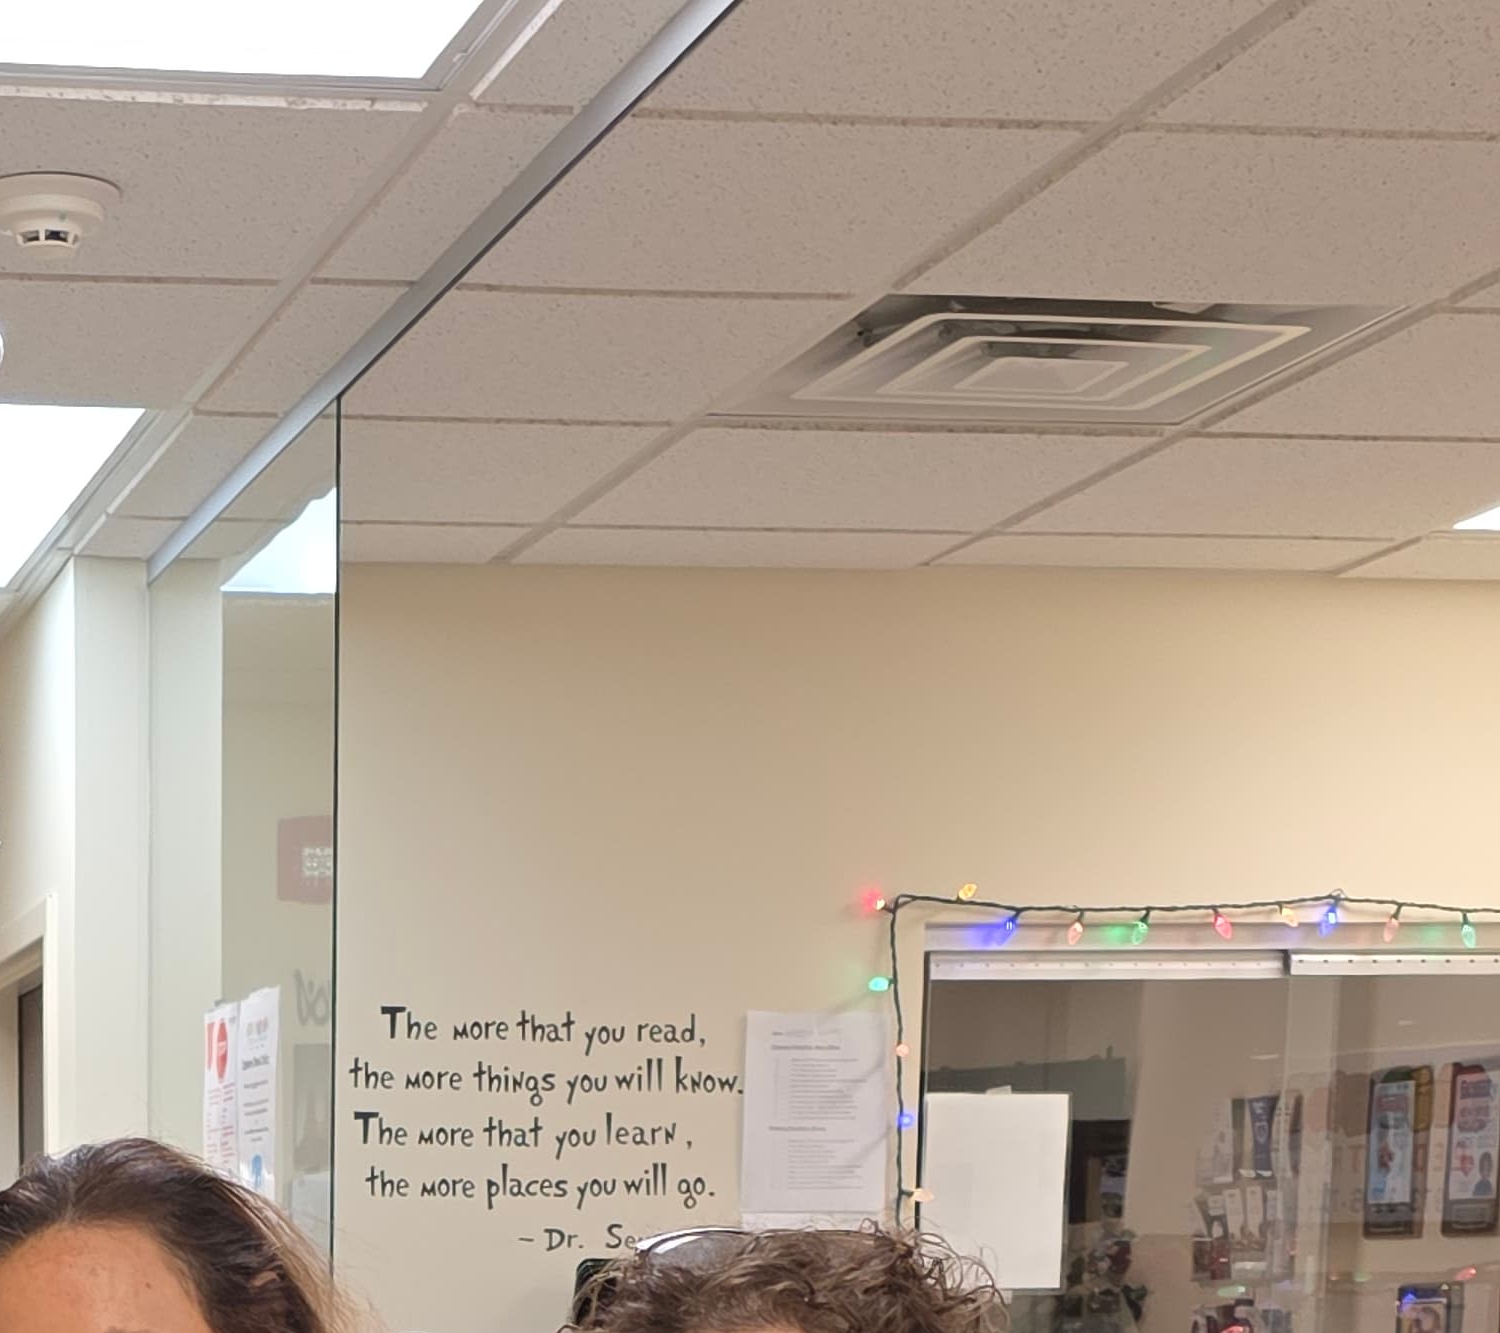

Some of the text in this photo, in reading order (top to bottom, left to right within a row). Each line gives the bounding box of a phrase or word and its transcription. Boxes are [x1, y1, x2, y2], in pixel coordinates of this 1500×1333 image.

[380, 1005, 706, 1057] The more that you read,
[348, 1055, 744, 1107] the more things you will know.
[353, 1110, 408, 1146] The
[417, 1127, 475, 1148] more
[482, 1115, 543, 1148] that
[555, 1128, 596, 1161] you
[365, 1162, 716, 1211] the more places you will go.
[543, 1228, 584, 1251] Dr.
